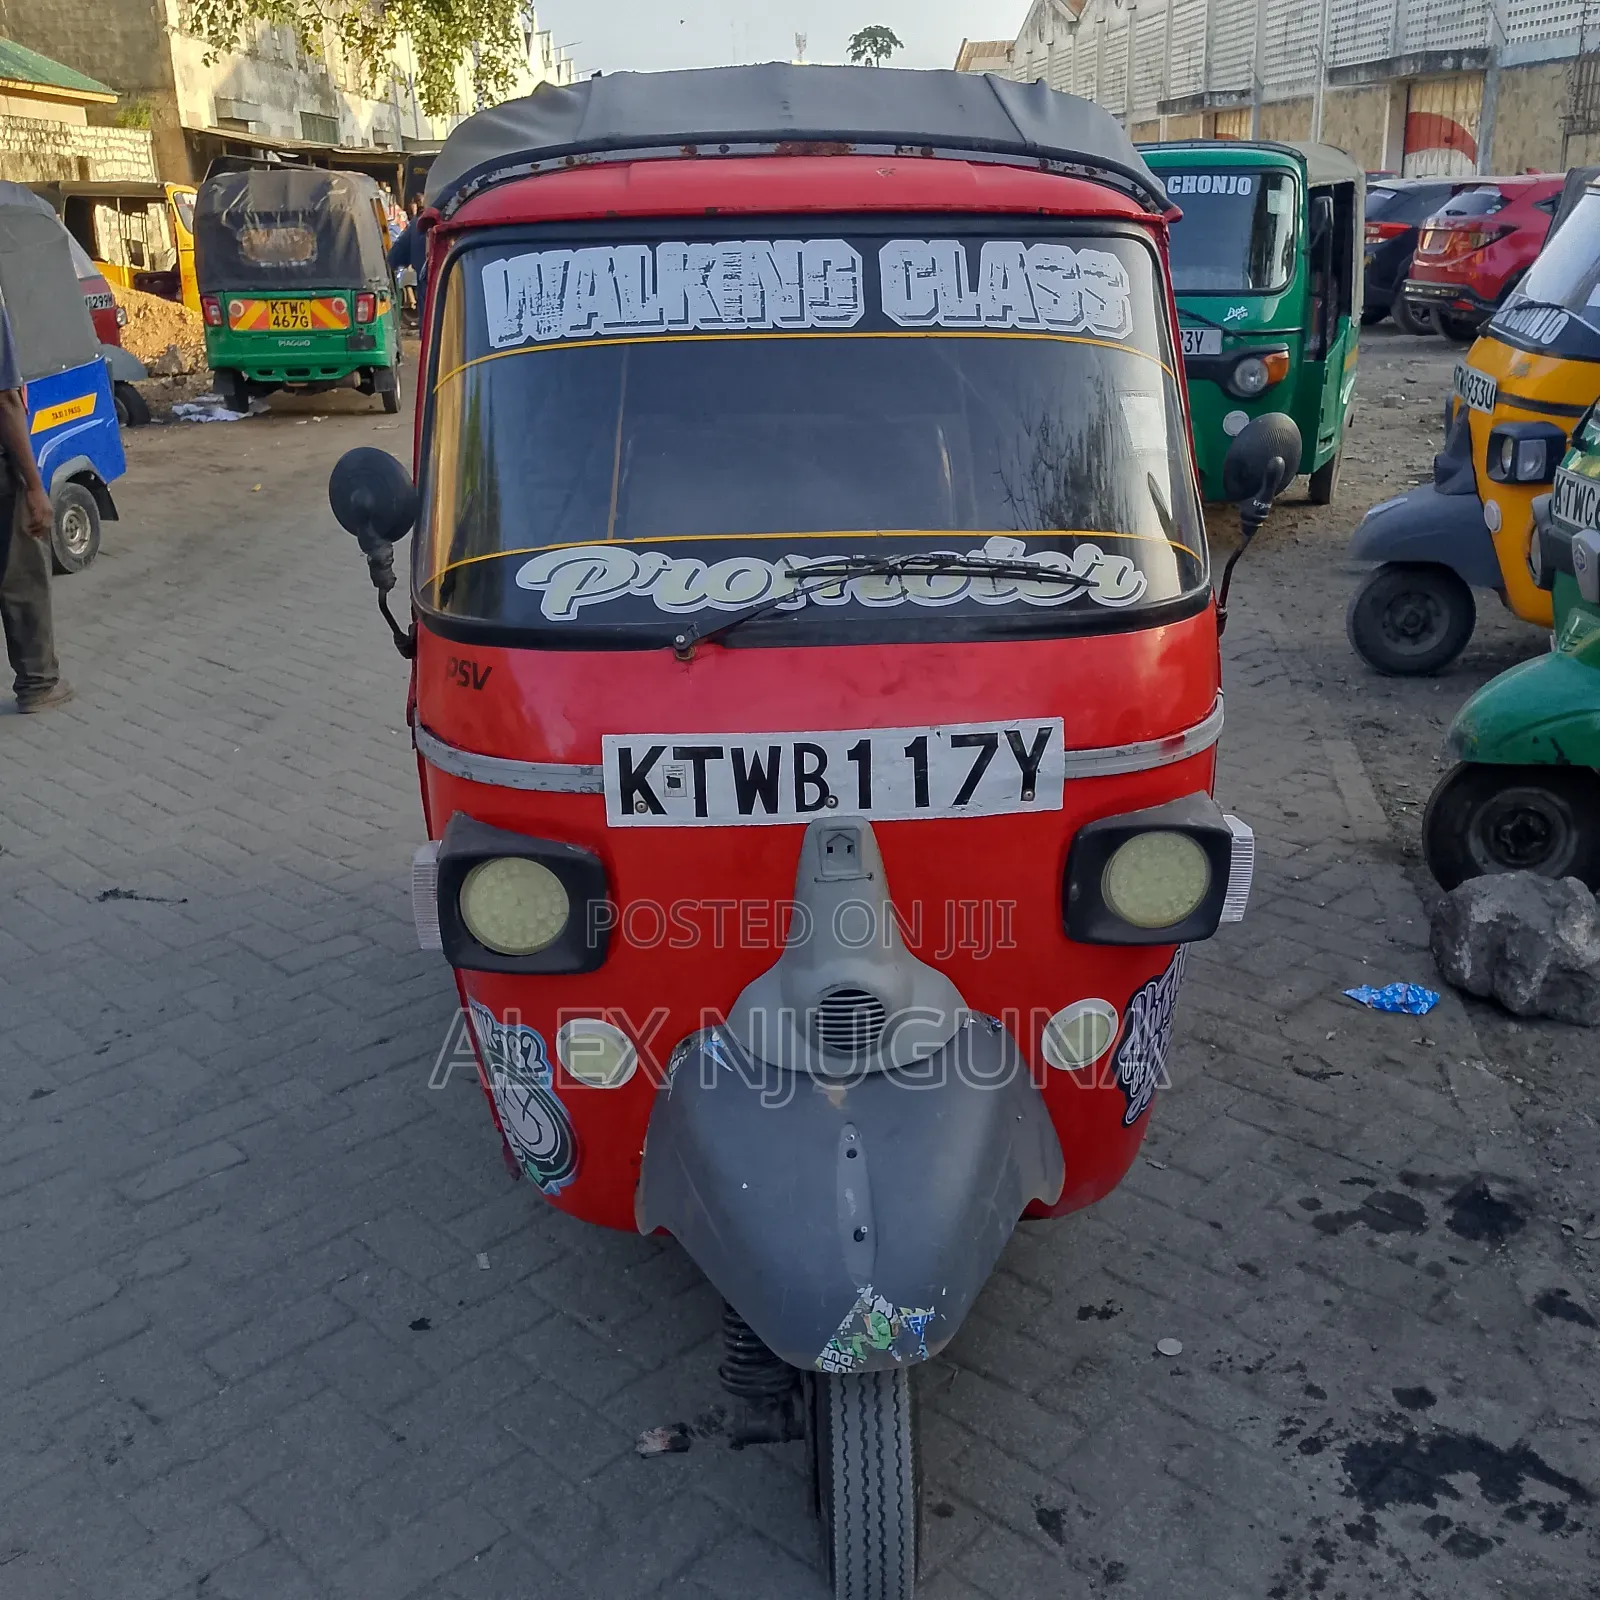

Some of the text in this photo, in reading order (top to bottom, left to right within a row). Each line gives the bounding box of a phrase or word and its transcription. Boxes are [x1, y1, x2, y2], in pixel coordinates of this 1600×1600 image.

[1167, 175, 1252, 196] CHONJO
[481, 239, 1134, 348] WALKING CLASS
[270, 301, 306, 315] KTWC
[273, 315, 309, 328] 467G
[1180, 331, 1204, 354] 3Y
[446, 656, 493, 690] PSV
[617, 726, 1053, 818] KTWB117Y
